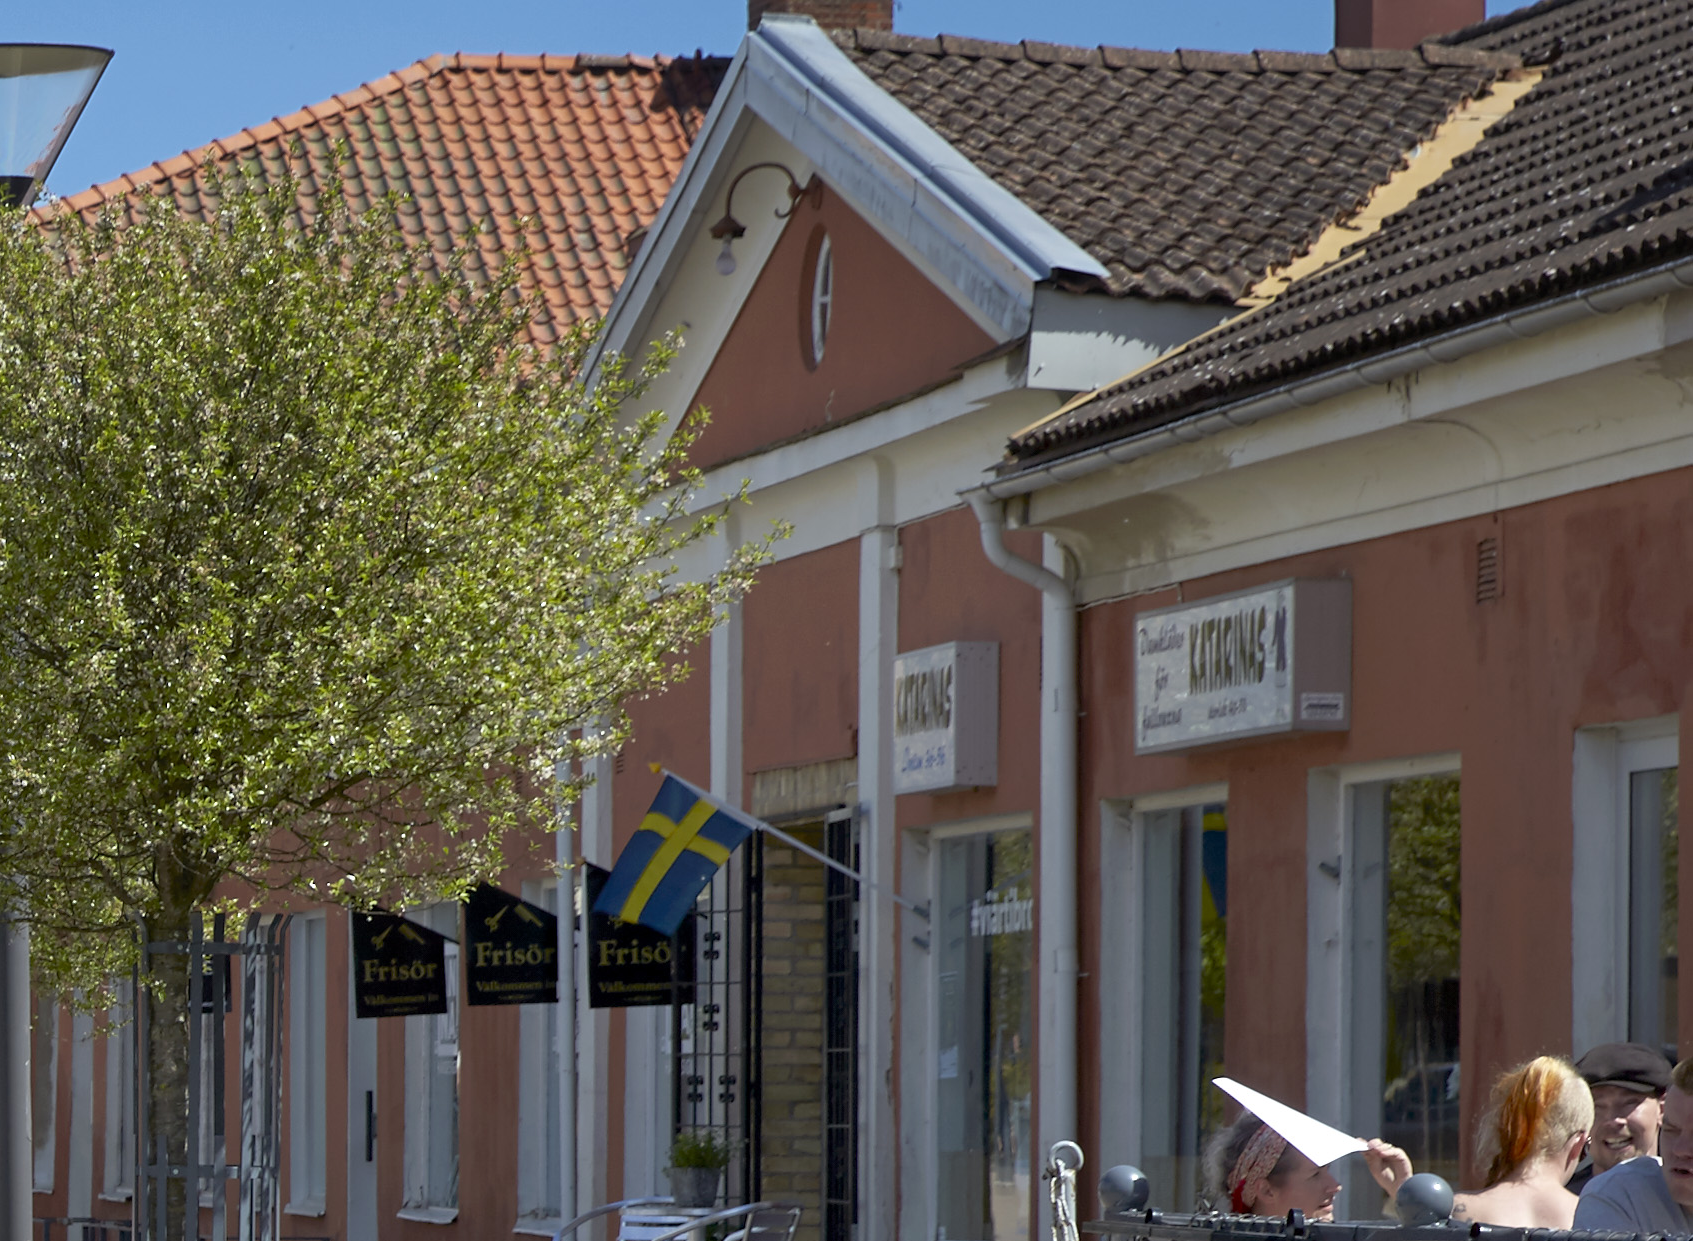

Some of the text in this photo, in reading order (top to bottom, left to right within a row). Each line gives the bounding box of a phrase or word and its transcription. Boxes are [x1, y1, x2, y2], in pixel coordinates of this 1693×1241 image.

[1188, 604, 1266, 697] KATARINAS
[895, 663, 953, 738] KATARINAS
[475, 941, 555, 968] Frisör
[598, 939, 672, 967] Frisö
[363, 958, 438, 982] Frisör
